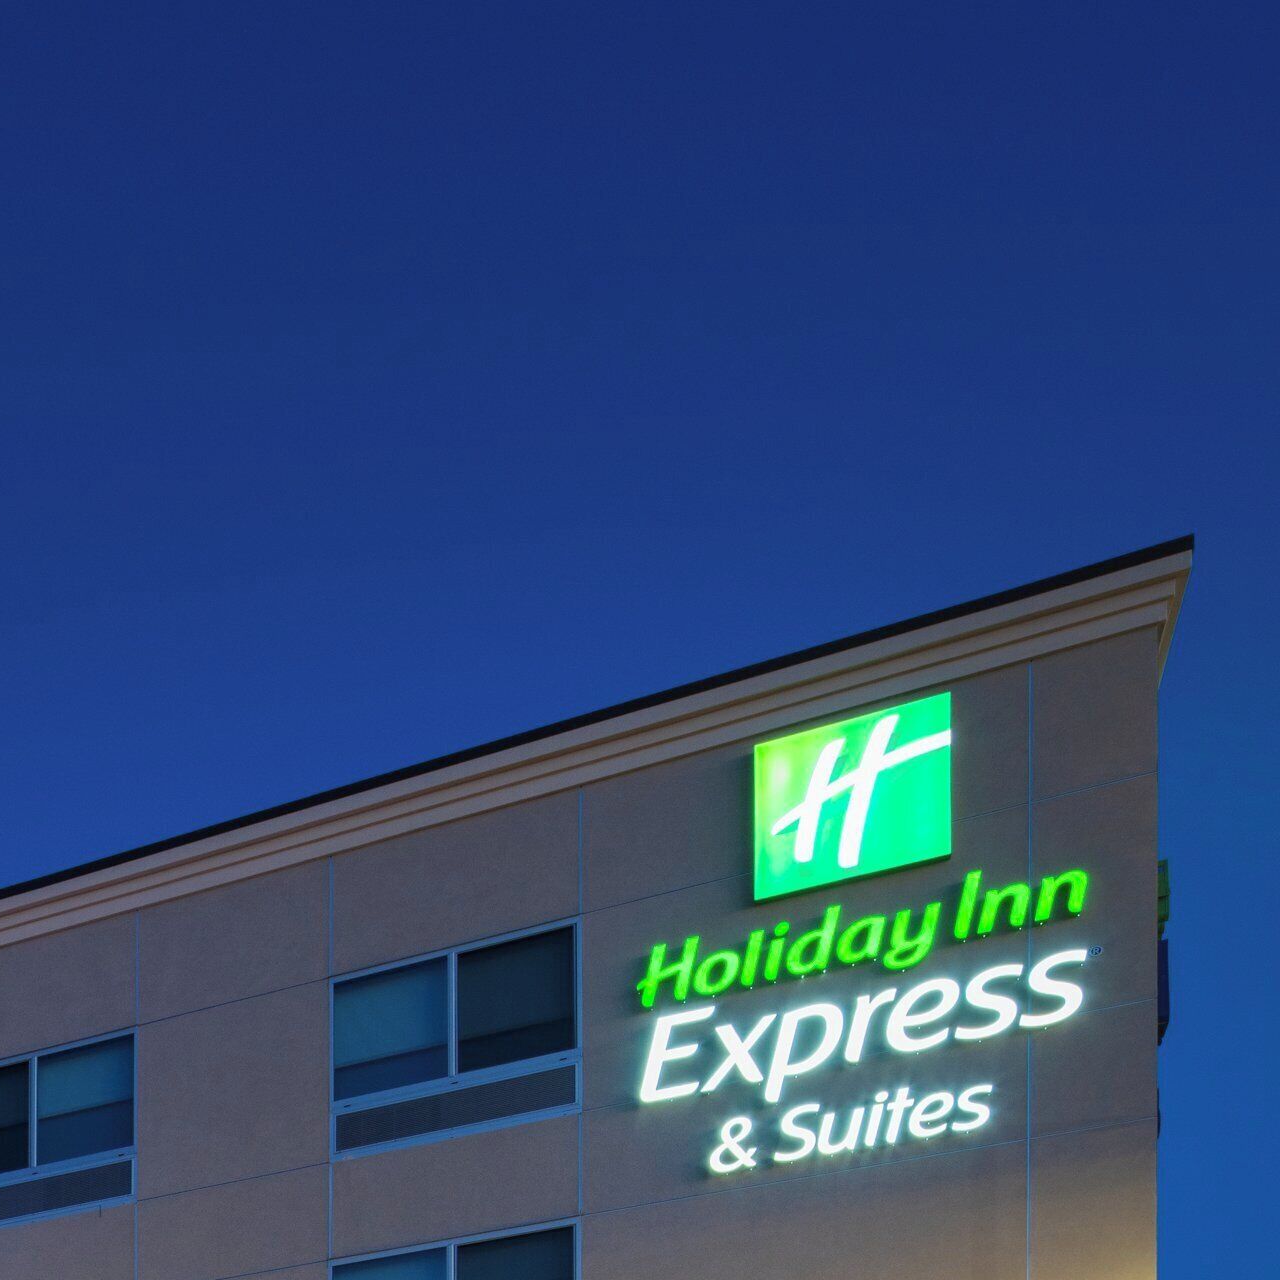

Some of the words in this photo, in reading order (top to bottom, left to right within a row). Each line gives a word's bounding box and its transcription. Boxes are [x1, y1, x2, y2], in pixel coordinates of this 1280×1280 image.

[637, 902, 942, 1008] Holiday
[953, 868, 1090, 941] Inn
[639, 948, 1088, 1103] Express
[708, 1115, 758, 1174] &
[773, 1083, 994, 1162] Suites
